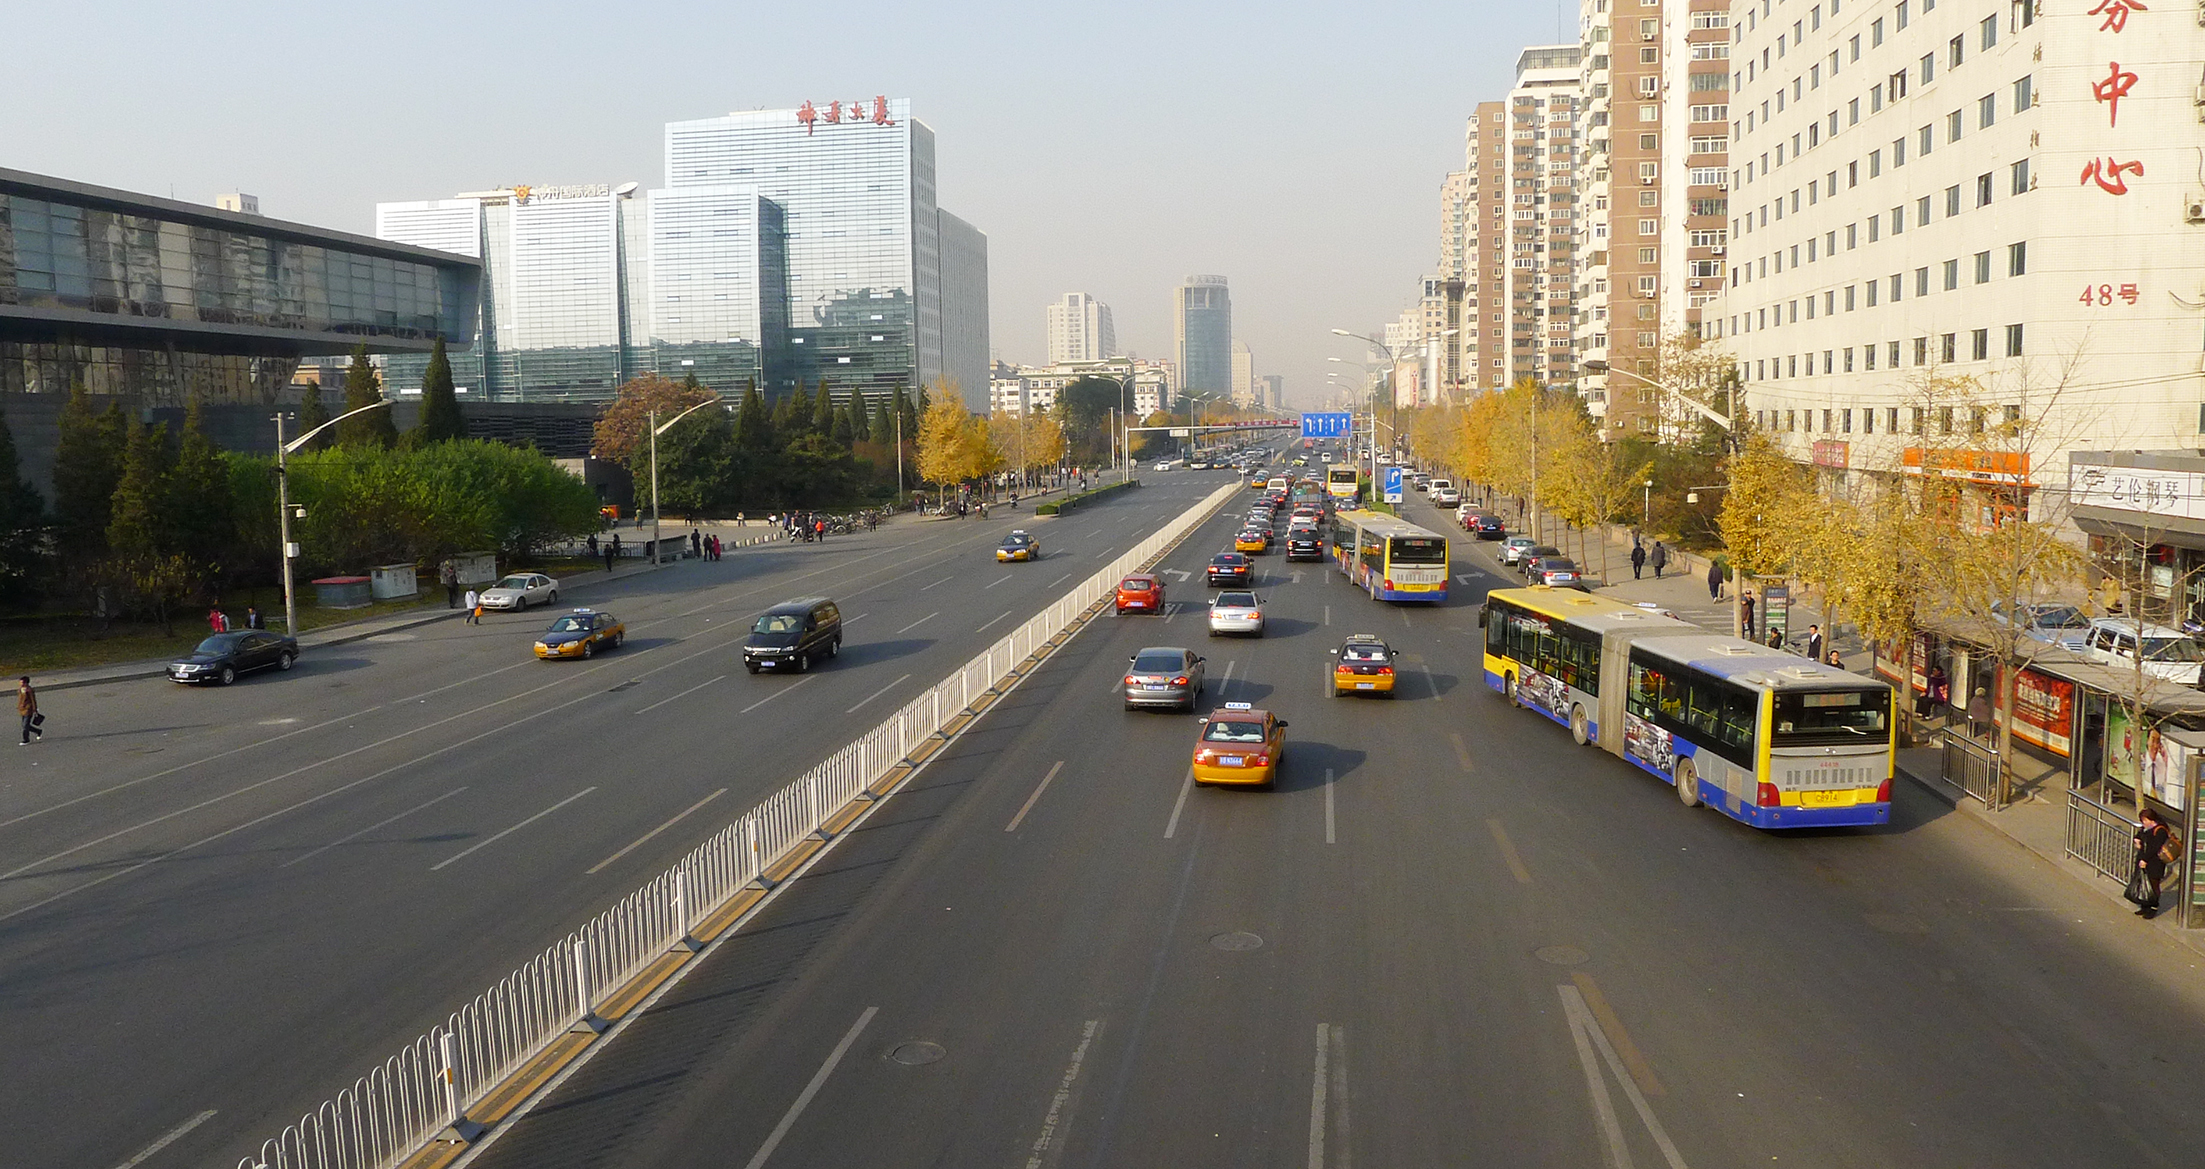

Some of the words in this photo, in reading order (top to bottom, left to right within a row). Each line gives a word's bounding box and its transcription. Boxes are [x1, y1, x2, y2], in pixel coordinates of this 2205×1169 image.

[2079, 283, 2140, 306] 48号
[2111, 476, 2179, 508] 艺伦钢琴
